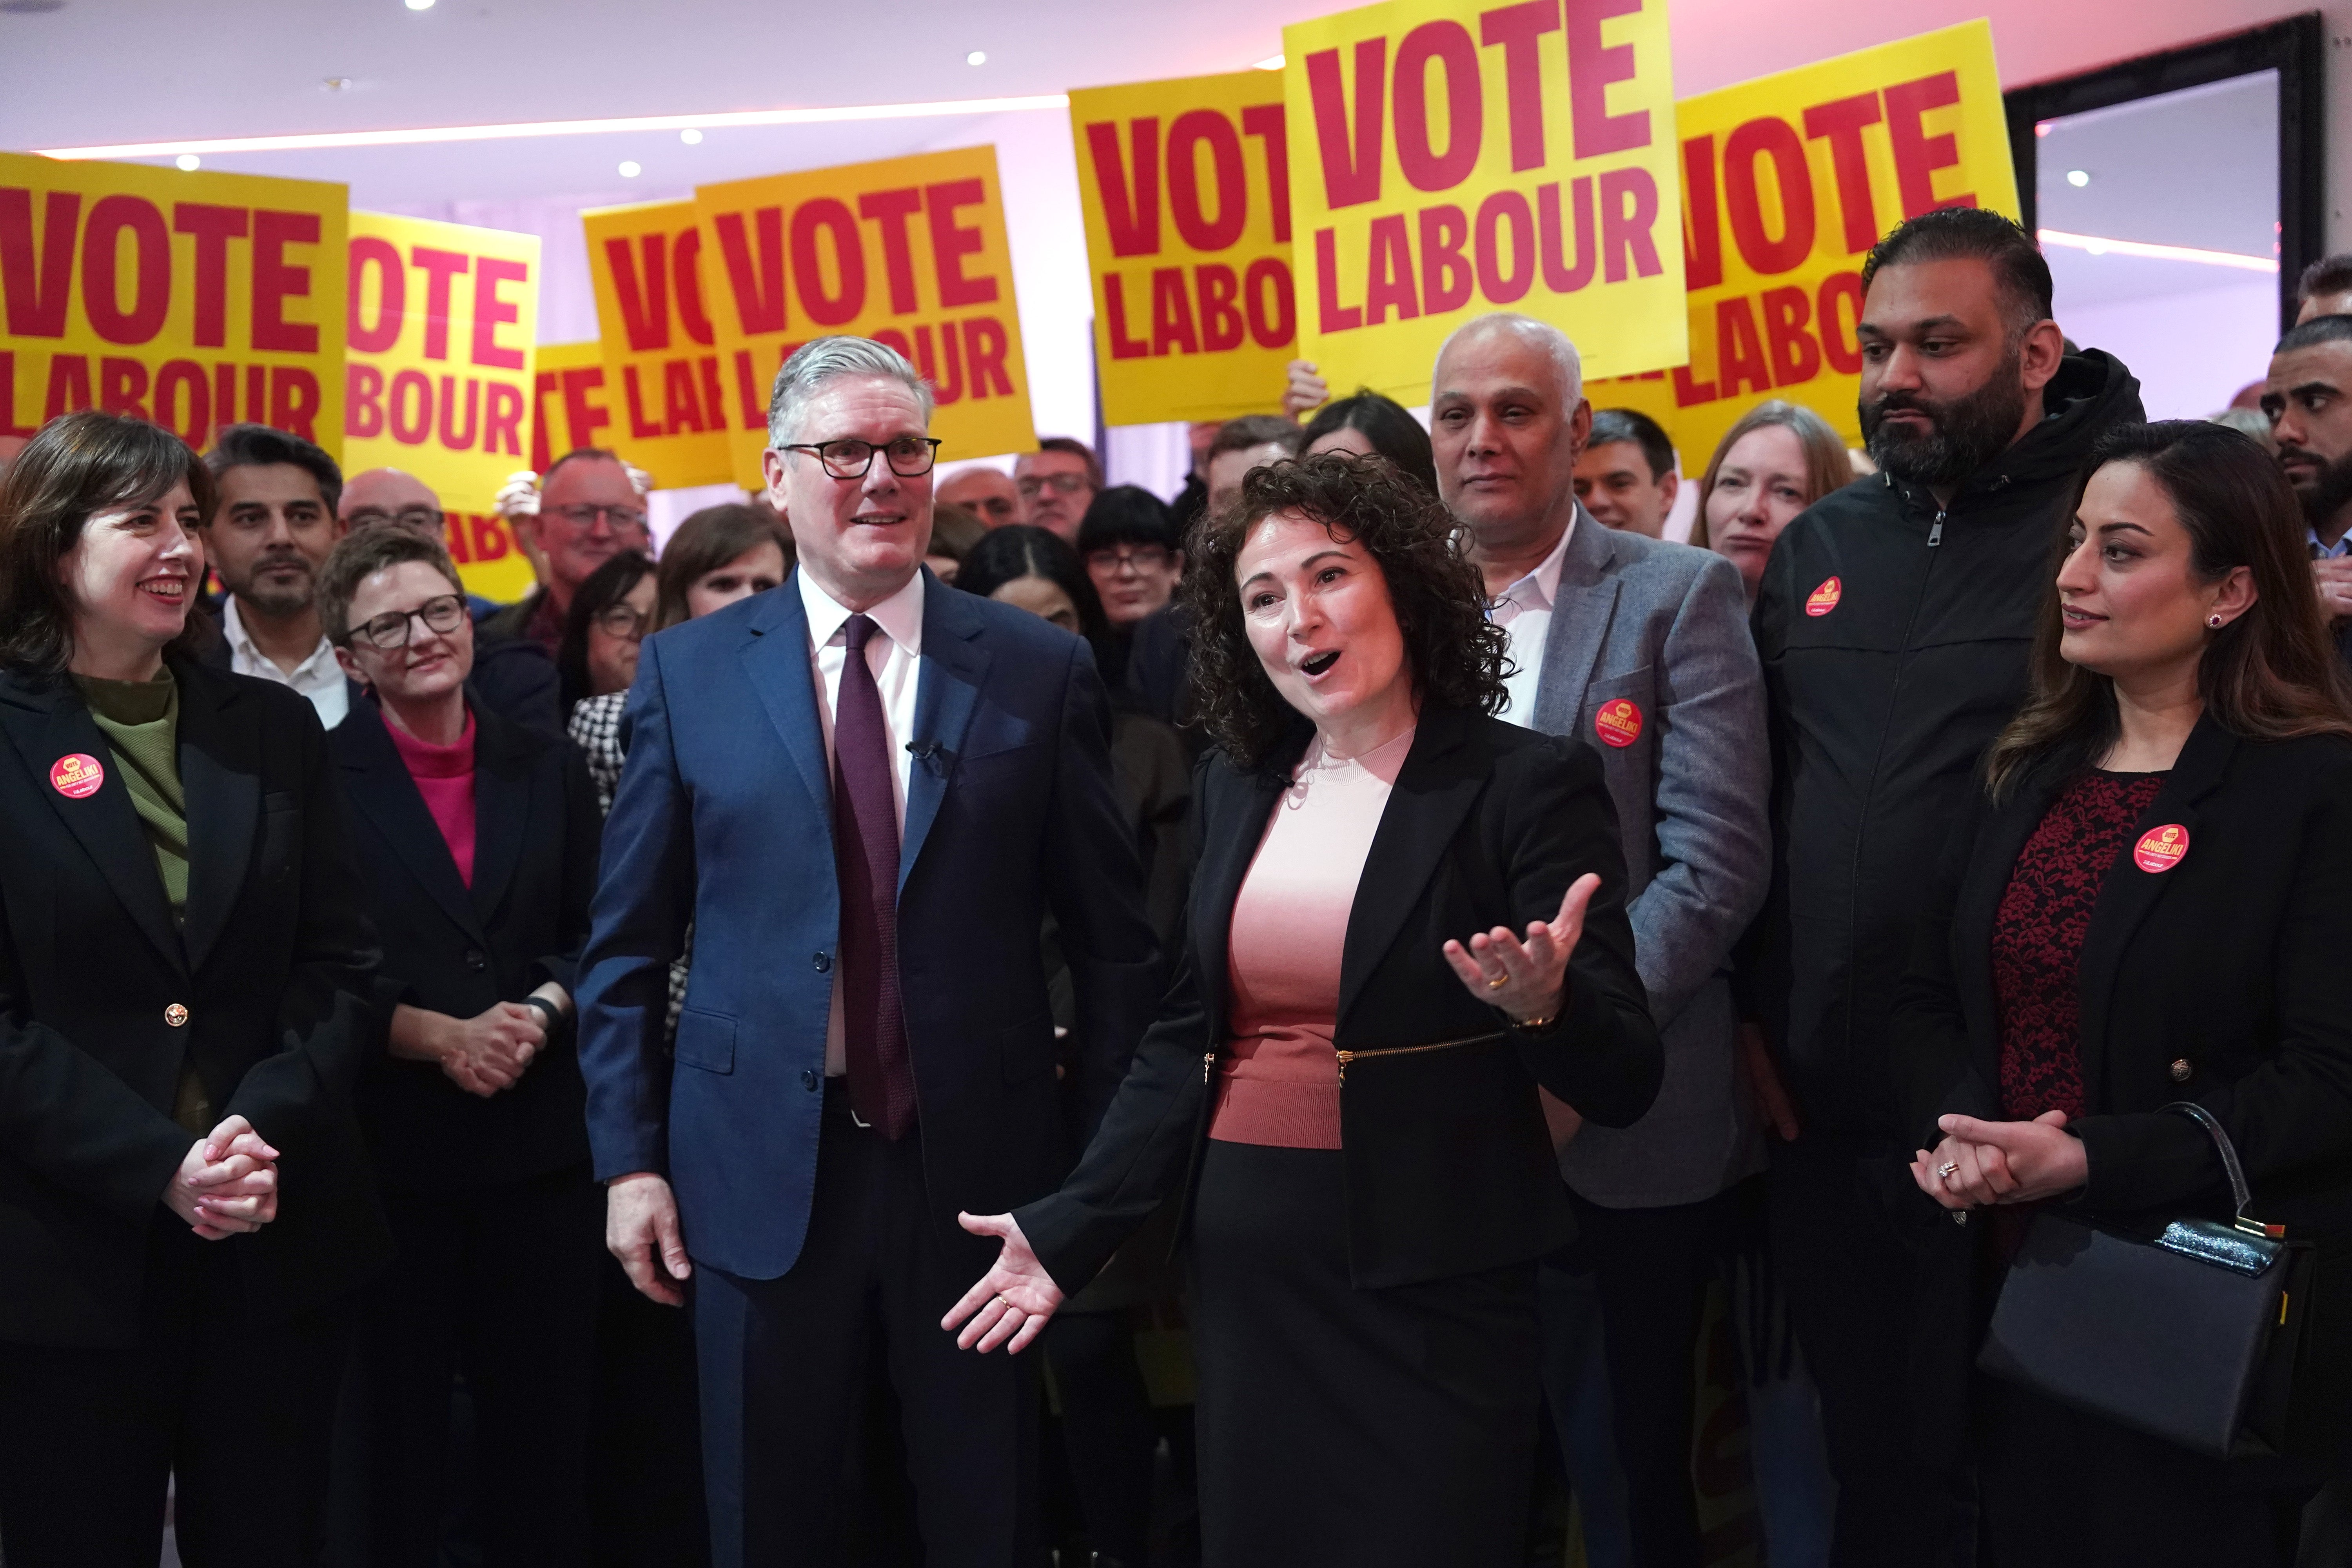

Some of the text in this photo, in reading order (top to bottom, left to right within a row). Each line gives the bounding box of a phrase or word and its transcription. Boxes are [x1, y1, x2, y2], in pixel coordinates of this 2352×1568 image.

[1305, 0, 1651, 211] VOTE
[1085, 104, 1292, 258] VOT
[1683, 69, 1977, 292] VOTE
[0, 186, 321, 353] VOTE
[347, 236, 528, 370] OTE
[714, 177, 998, 336] VOTE
[1103, 256, 1296, 361] LABO
[1314, 166, 1663, 334] LABOUR
[735, 317, 1014, 430] LUR
[1672, 271, 1865, 408] LABO
[344, 362, 524, 456] BOUR
[56, 764, 99, 786] ANGELIKI
[1600, 712, 1638, 733] ANGELIKI
[2140, 838, 2184, 856] ANGELIKI
